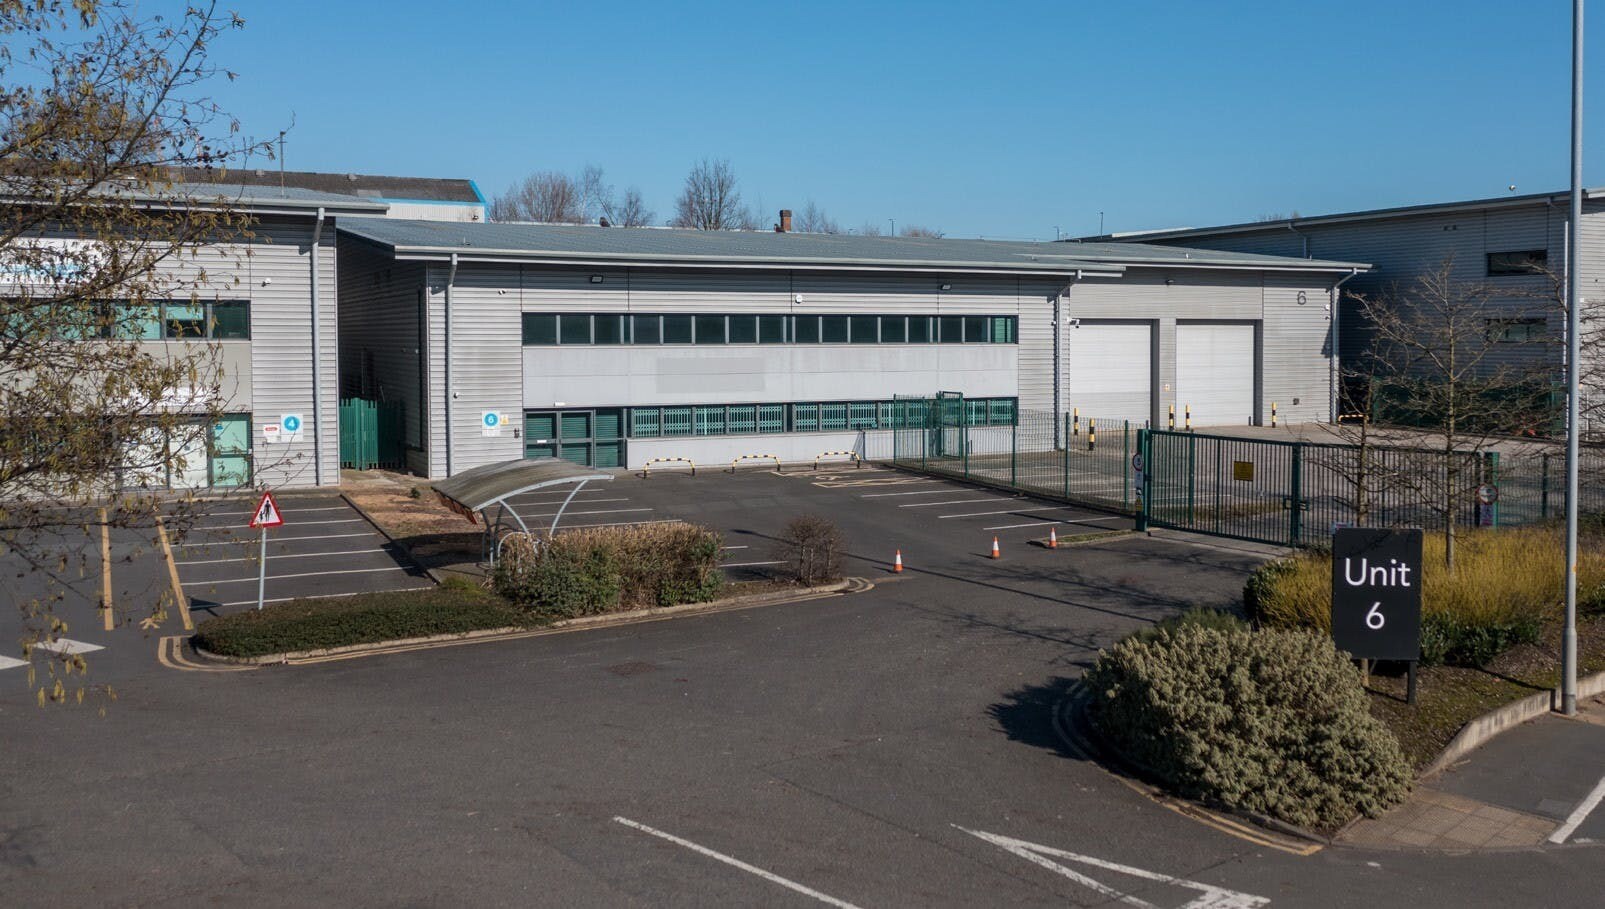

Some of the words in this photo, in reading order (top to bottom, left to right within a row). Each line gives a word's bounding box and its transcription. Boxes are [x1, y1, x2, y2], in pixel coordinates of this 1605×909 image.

[1297, 290, 1306, 305] 6
[1345, 558, 1411, 587] Unit
[1366, 601, 1385, 630] 6
